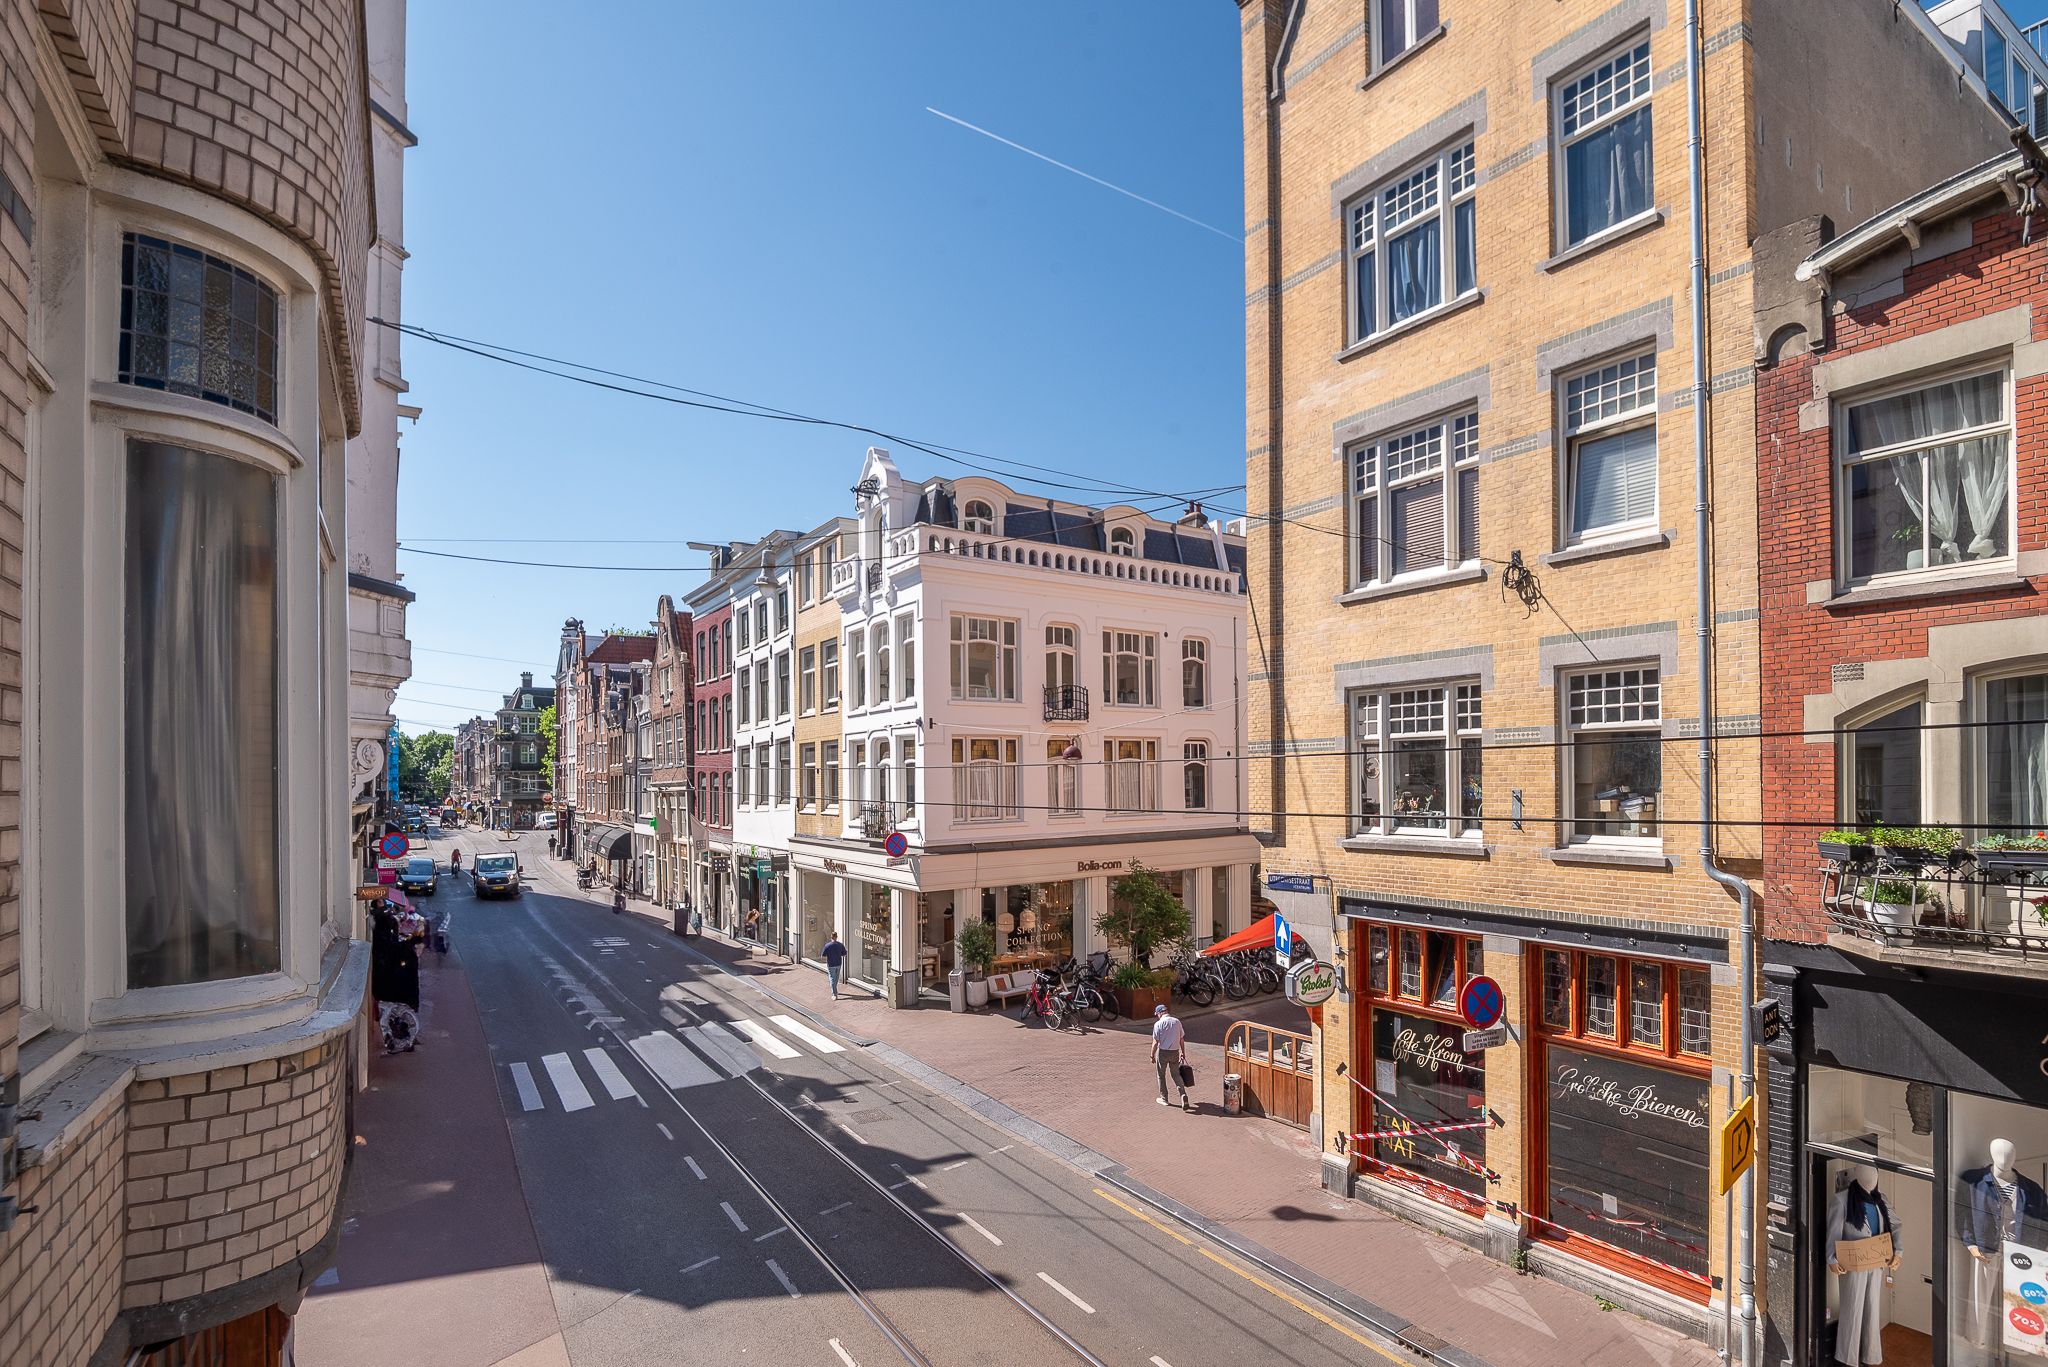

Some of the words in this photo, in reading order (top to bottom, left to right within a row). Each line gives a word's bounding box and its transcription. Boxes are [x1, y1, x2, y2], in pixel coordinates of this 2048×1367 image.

[361, 889, 386, 897] Aesop
[859, 920, 878, 931] SPRING
[1017, 923, 1050, 935] SPRING
[854, 928, 884, 944] COLLECTION
[1006, 932, 1063, 947] COLLECTION
[1301, 972, 1332, 995] Grolsch
[1764, 1008, 1777, 1024] ANT
[1764, 1023, 1778, 1038] OON
[1619, 1085, 1704, 1128] Bieren
[1382, 1136, 1416, 1159] NAT
[1737, 1129, 1743, 1155] K
[2023, 1289, 2047, 1299] 50%
[2013, 1312, 2040, 1331] 70%
